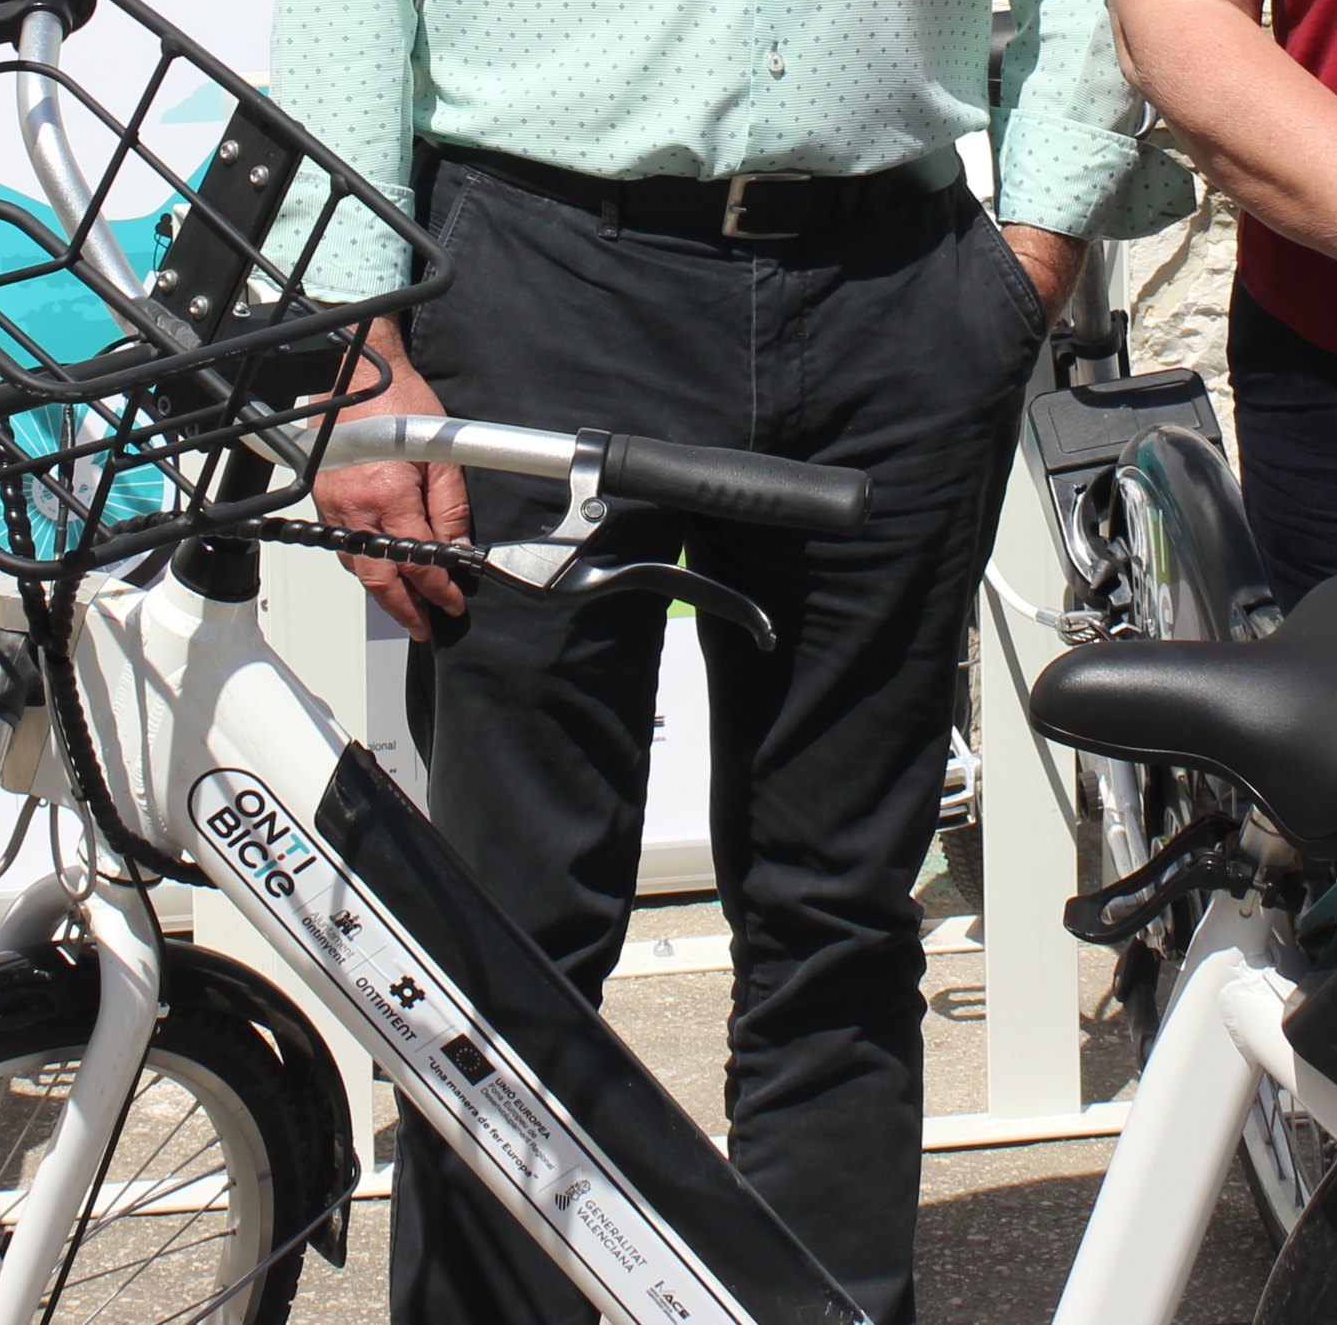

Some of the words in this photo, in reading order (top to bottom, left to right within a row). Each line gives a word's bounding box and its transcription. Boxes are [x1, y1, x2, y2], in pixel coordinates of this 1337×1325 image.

[235, 788, 318, 875] ONTI
[445, 1081, 479, 1118] manera
[477, 1115, 491, 1130] de
[489, 1127, 504, 1144] fer
[514, 1099, 551, 1141] EUROPEA
[529, 1140, 556, 1171] Regional
[577, 1207, 635, 1274] VALENCIANA
[585, 1199, 647, 1267] GENERALITAT
